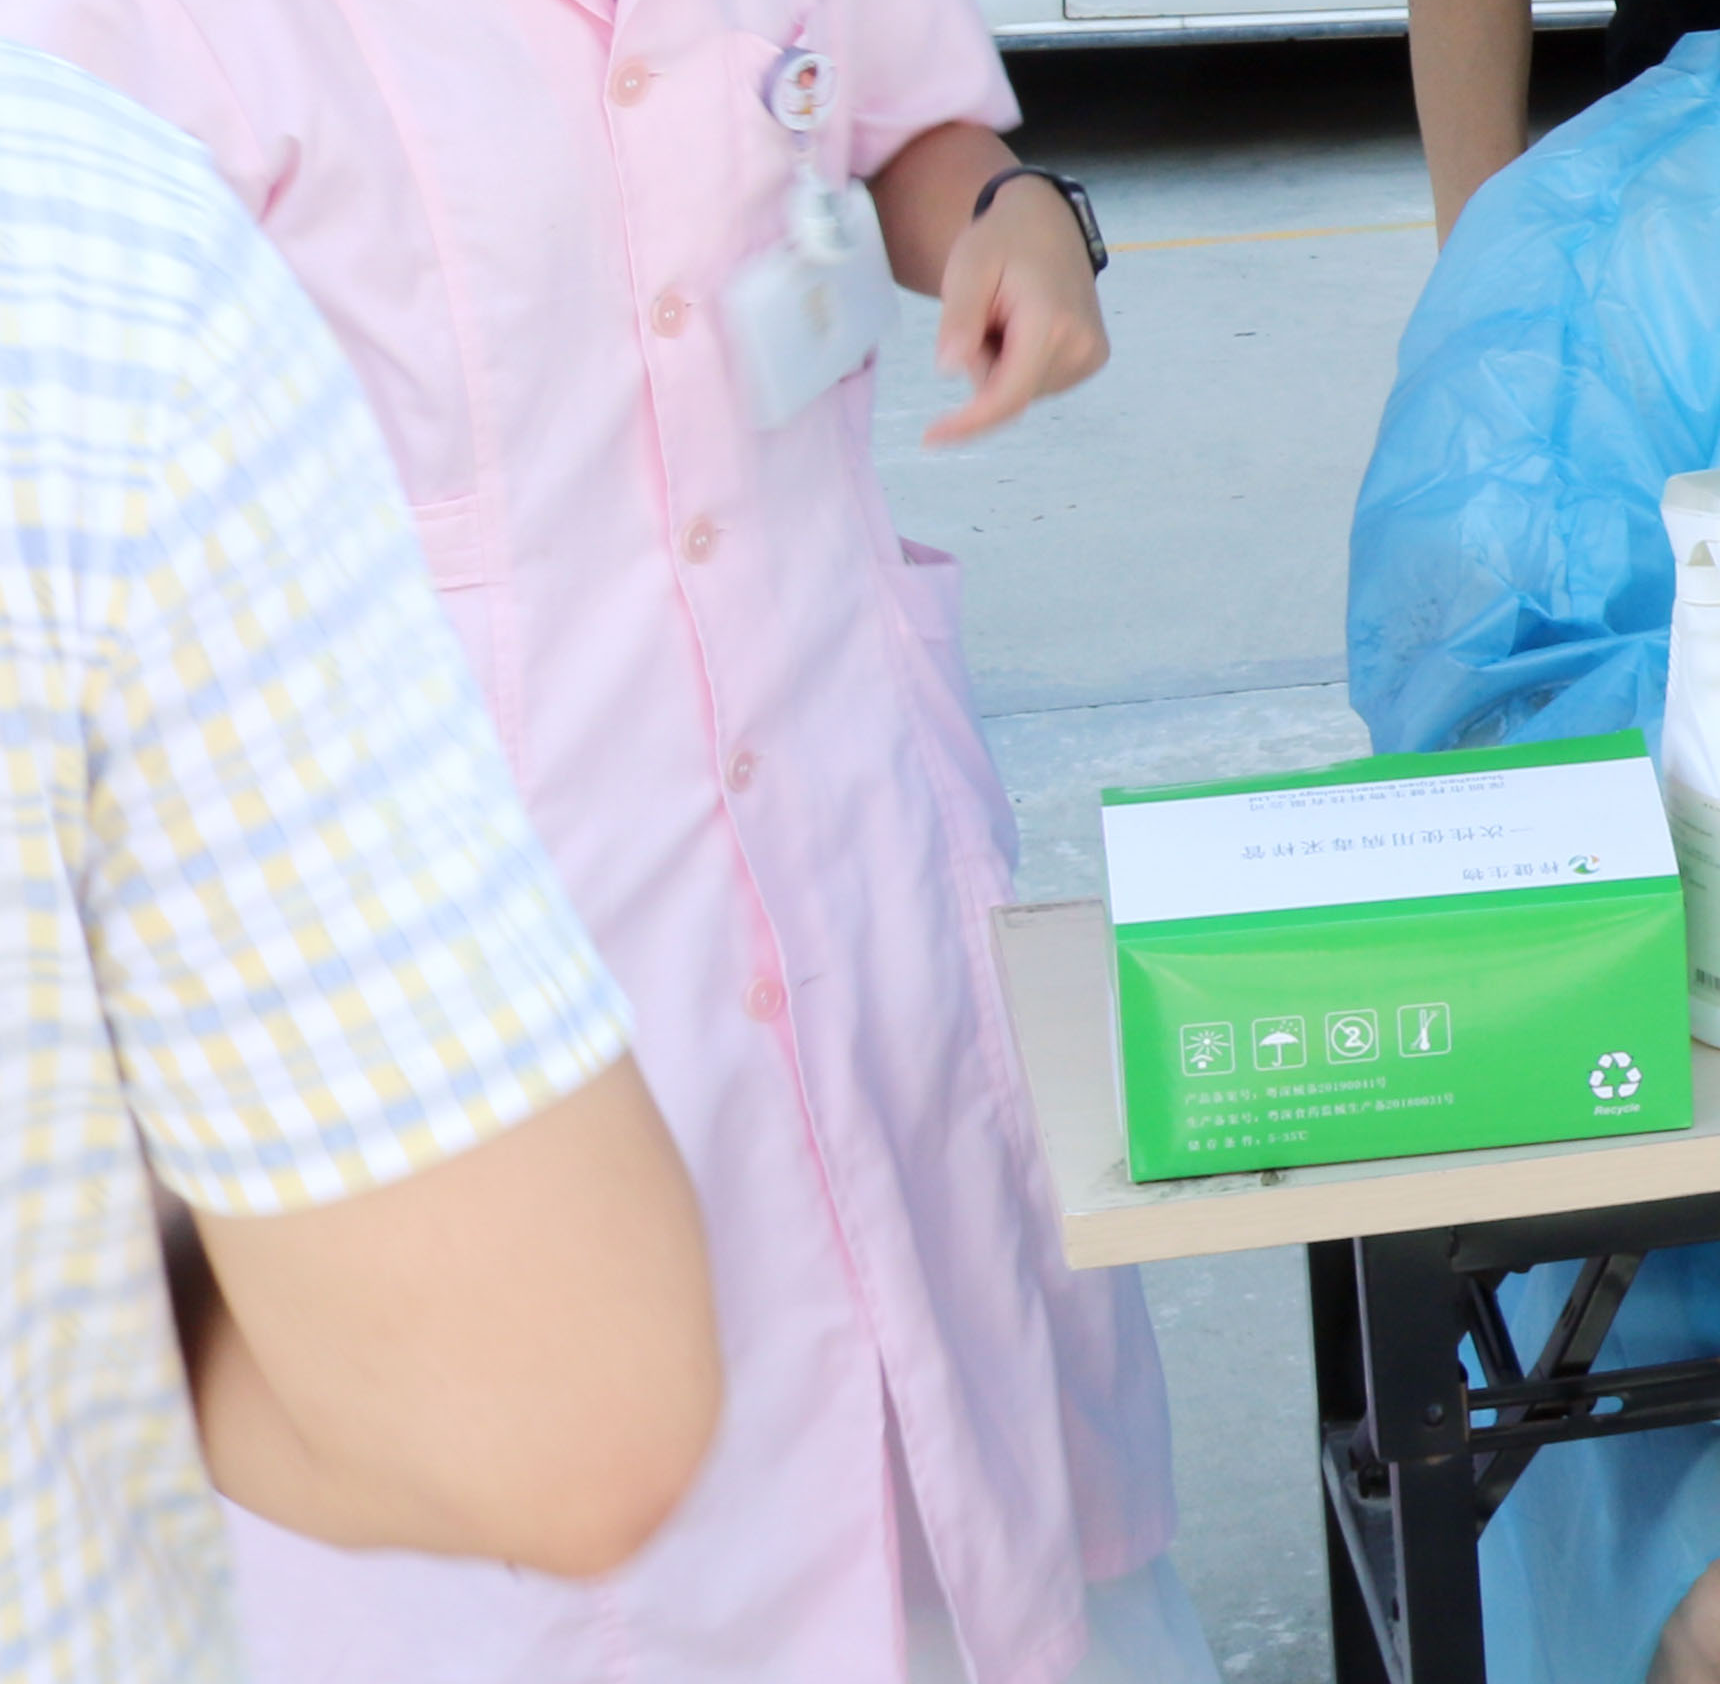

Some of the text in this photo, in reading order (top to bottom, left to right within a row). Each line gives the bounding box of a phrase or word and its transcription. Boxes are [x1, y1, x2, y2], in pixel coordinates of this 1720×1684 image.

[1240, 824, 1534, 859] 一次性使用病毒采样管
